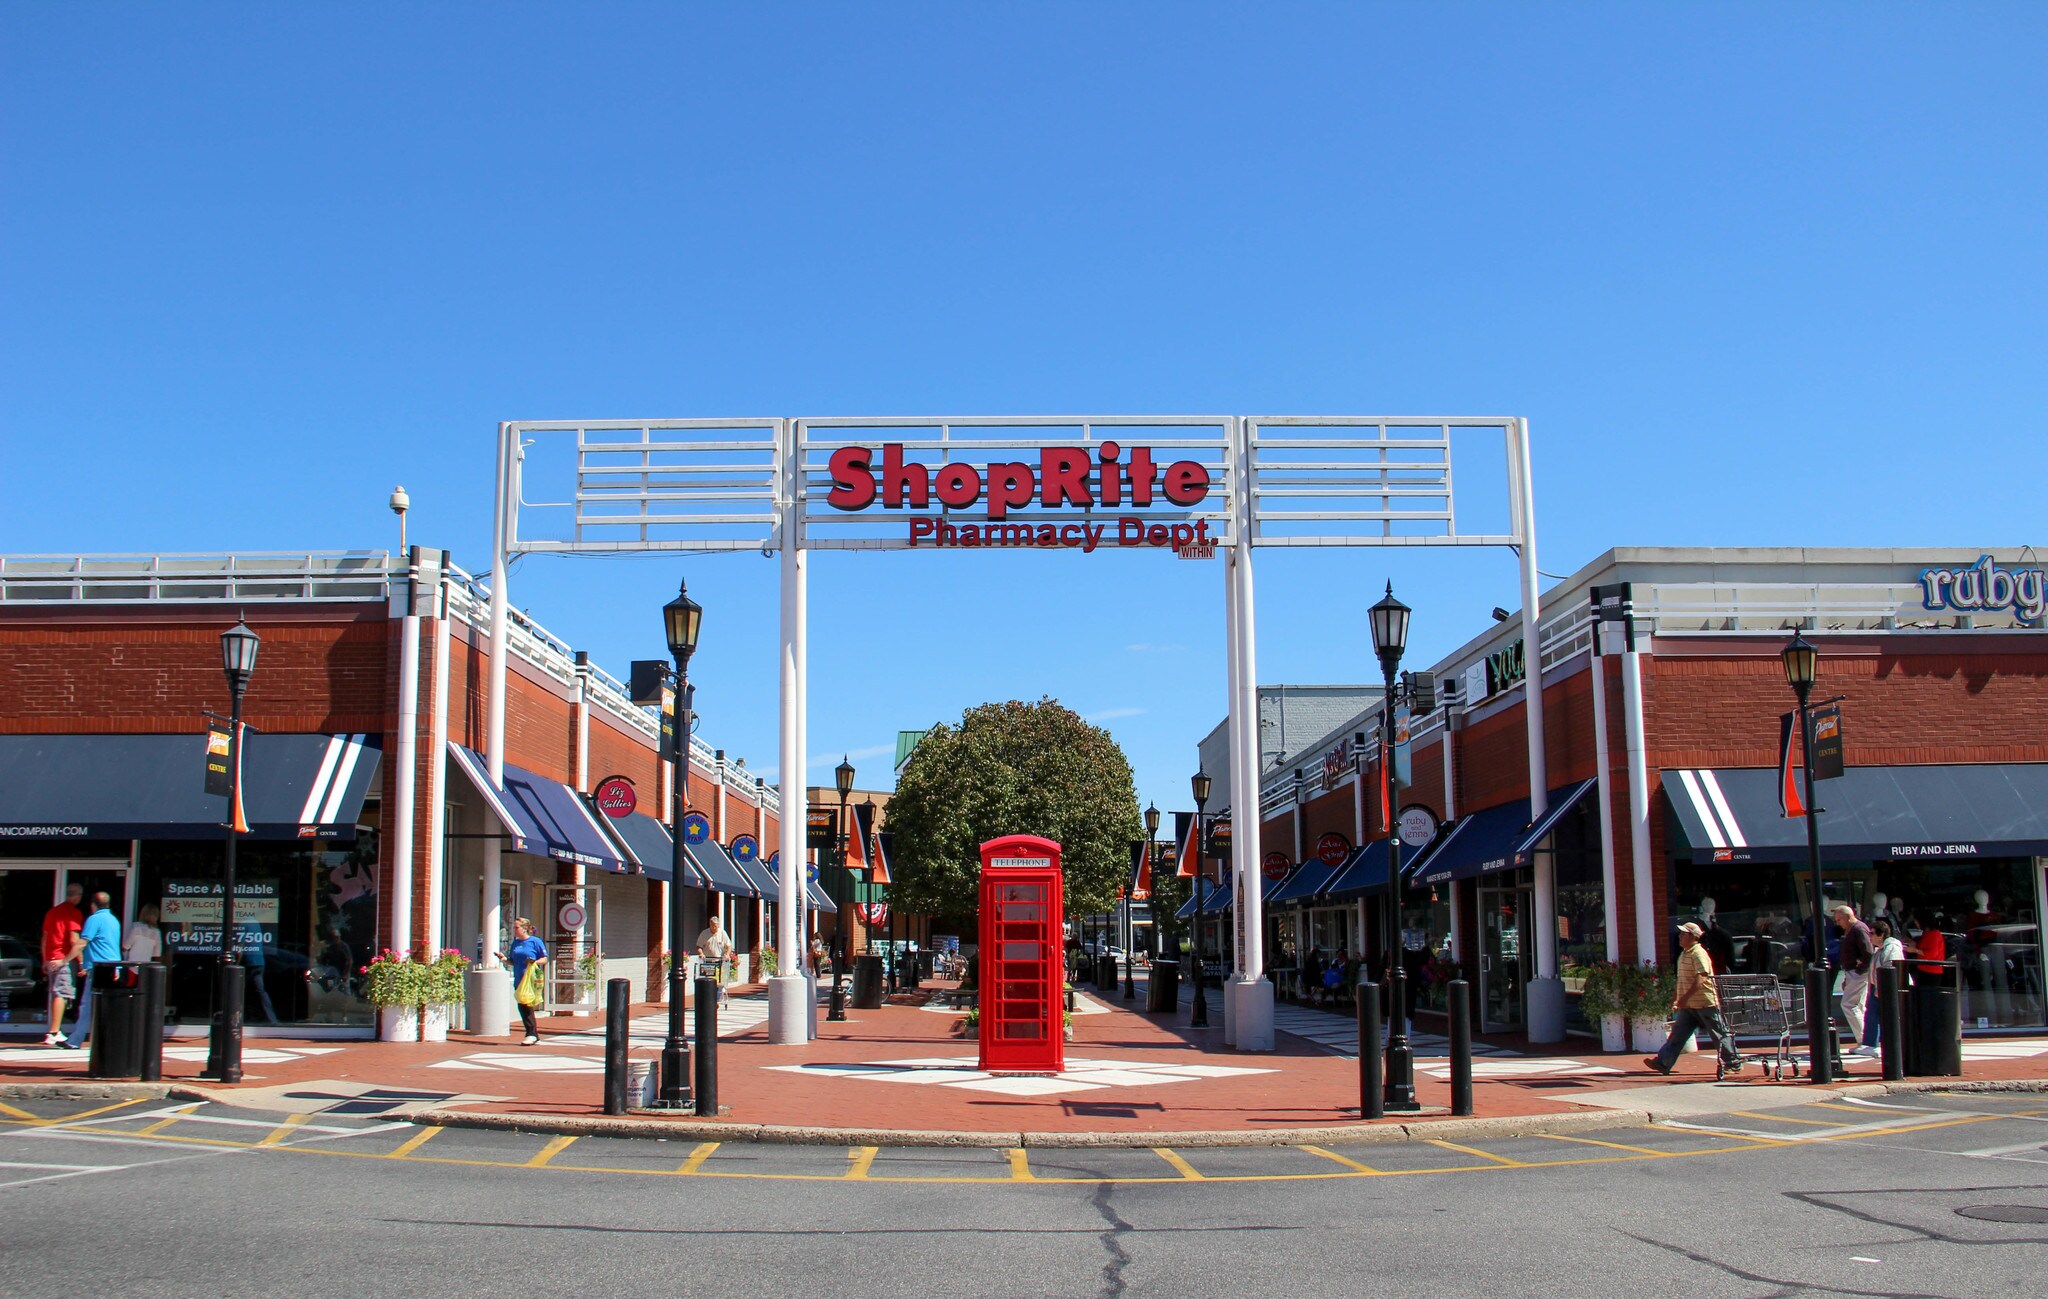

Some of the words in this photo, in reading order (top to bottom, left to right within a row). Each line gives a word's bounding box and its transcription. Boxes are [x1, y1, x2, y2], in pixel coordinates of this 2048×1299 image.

[827, 441, 1210, 521] ShopRite
[908, 517, 1105, 553] Pharmacy
[1118, 517, 1219, 553] Dept.
[1181, 546, 1213, 558] WITHIN
[1921, 554, 2046, 622] ruby
[609, 786, 625, 798] Liz
[603, 799, 632, 808] Gillies
[1406, 816, 1426, 826] ruby
[1405, 831, 1428, 839] jenna
[1891, 846, 1918, 855] RUBY
[1920, 845, 1941, 854] AND
[1943, 844, 1976, 854] JENNA
[995, 858, 1047, 866] TELEPHONE
[168, 884, 208, 895] Space
[212, 884, 273, 894] Ailable
[218, 901, 256, 909] RALTY,
[165, 931, 272, 945] (914)57-7500
[178, 945, 260, 953] www.welcolty.com
